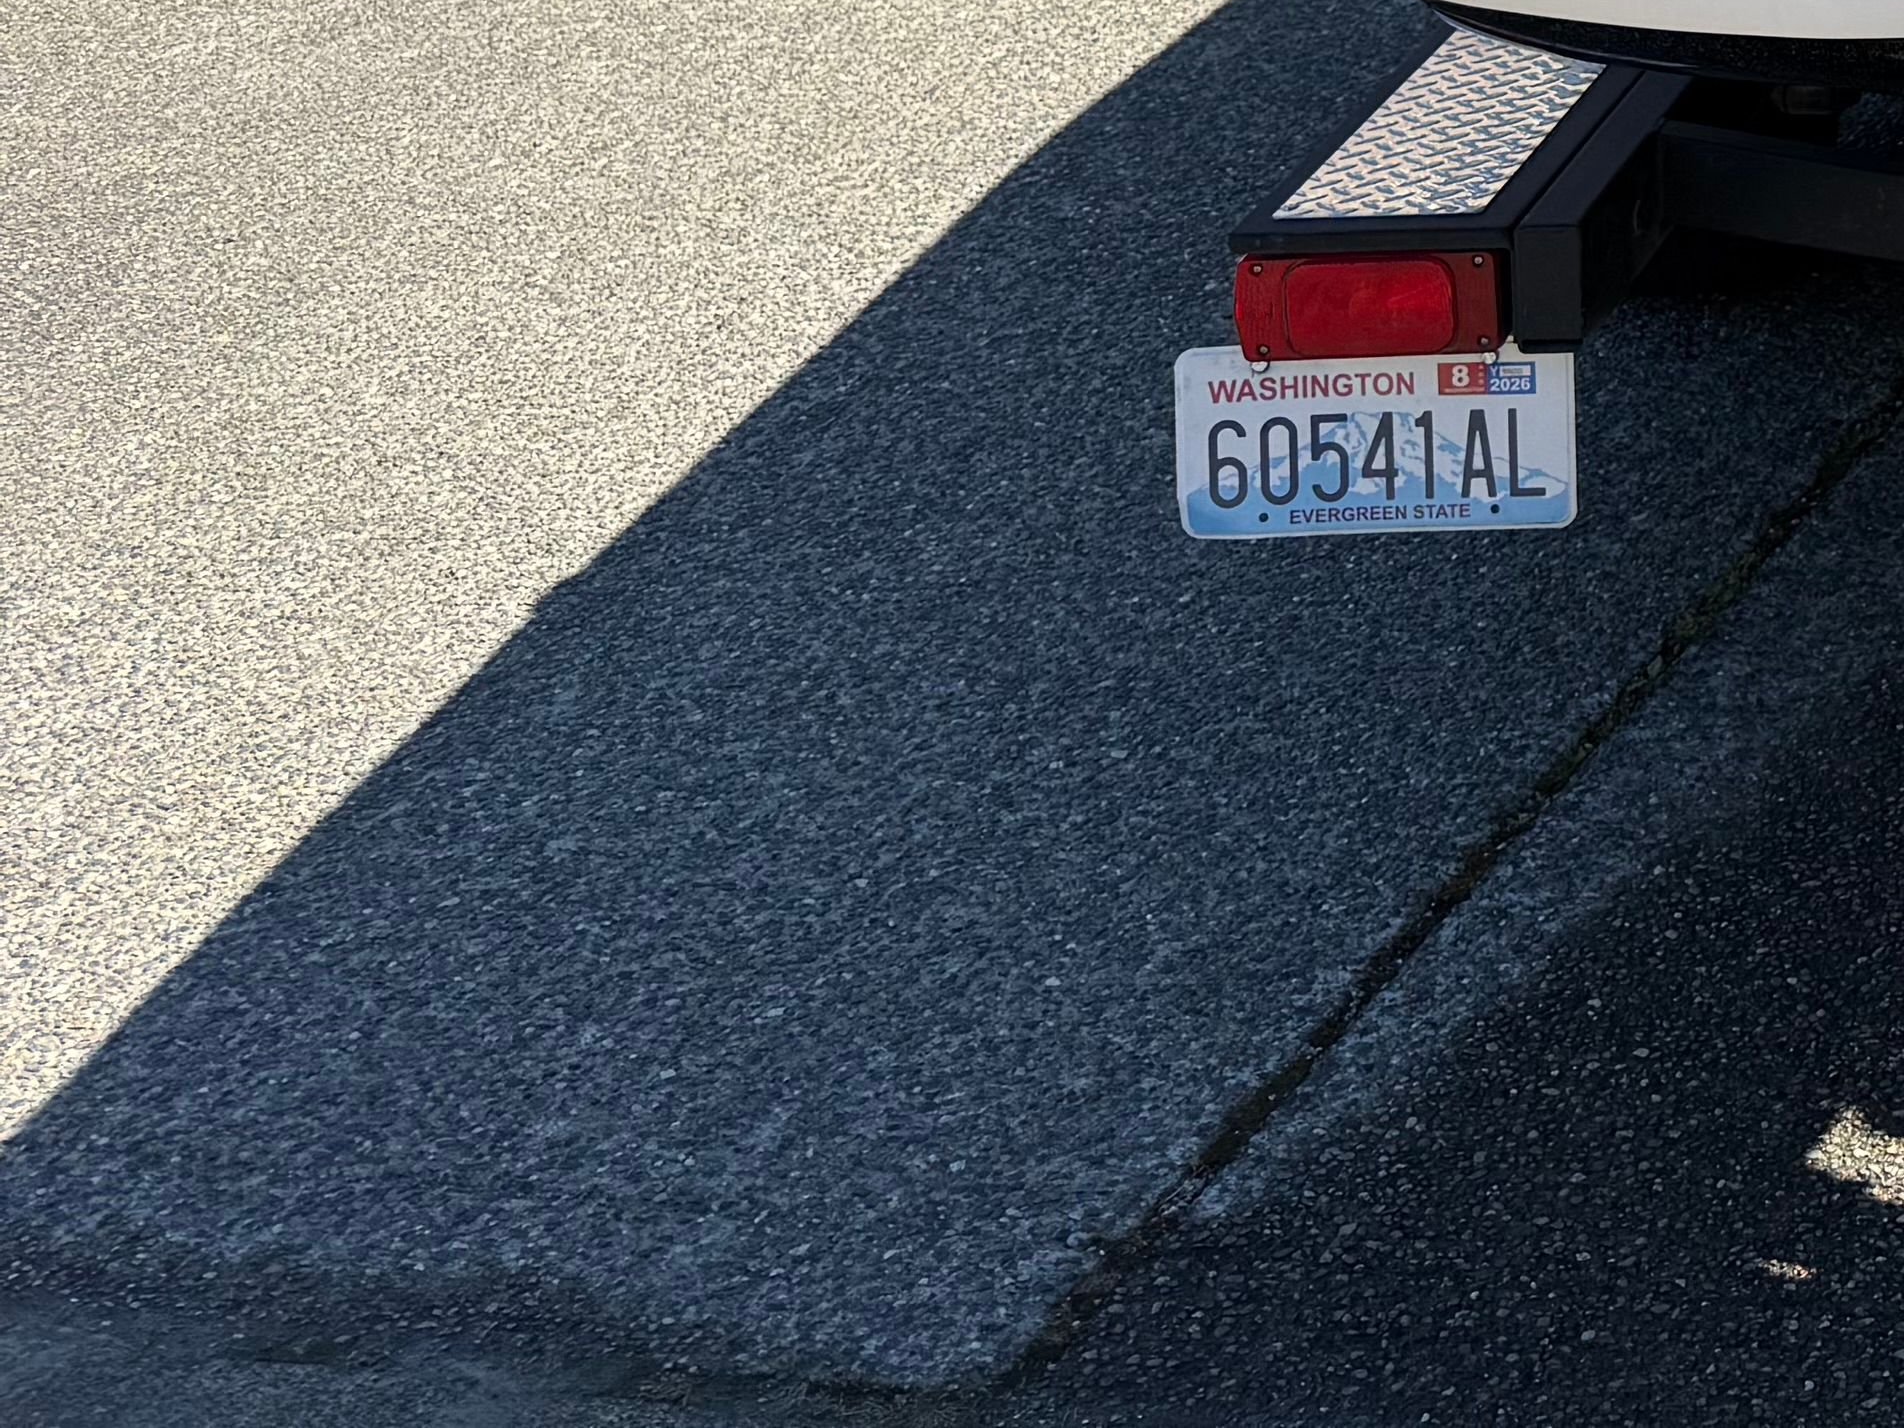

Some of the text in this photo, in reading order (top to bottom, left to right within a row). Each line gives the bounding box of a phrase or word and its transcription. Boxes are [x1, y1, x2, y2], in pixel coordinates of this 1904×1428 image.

[1208, 371, 1416, 404] WASHINGTON
[1452, 365, 1470, 387] 8
[1490, 378, 1531, 392] 2026
[1208, 407, 1546, 509] 60541AL
[1289, 503, 1472, 525] EVERGREEN STATE
